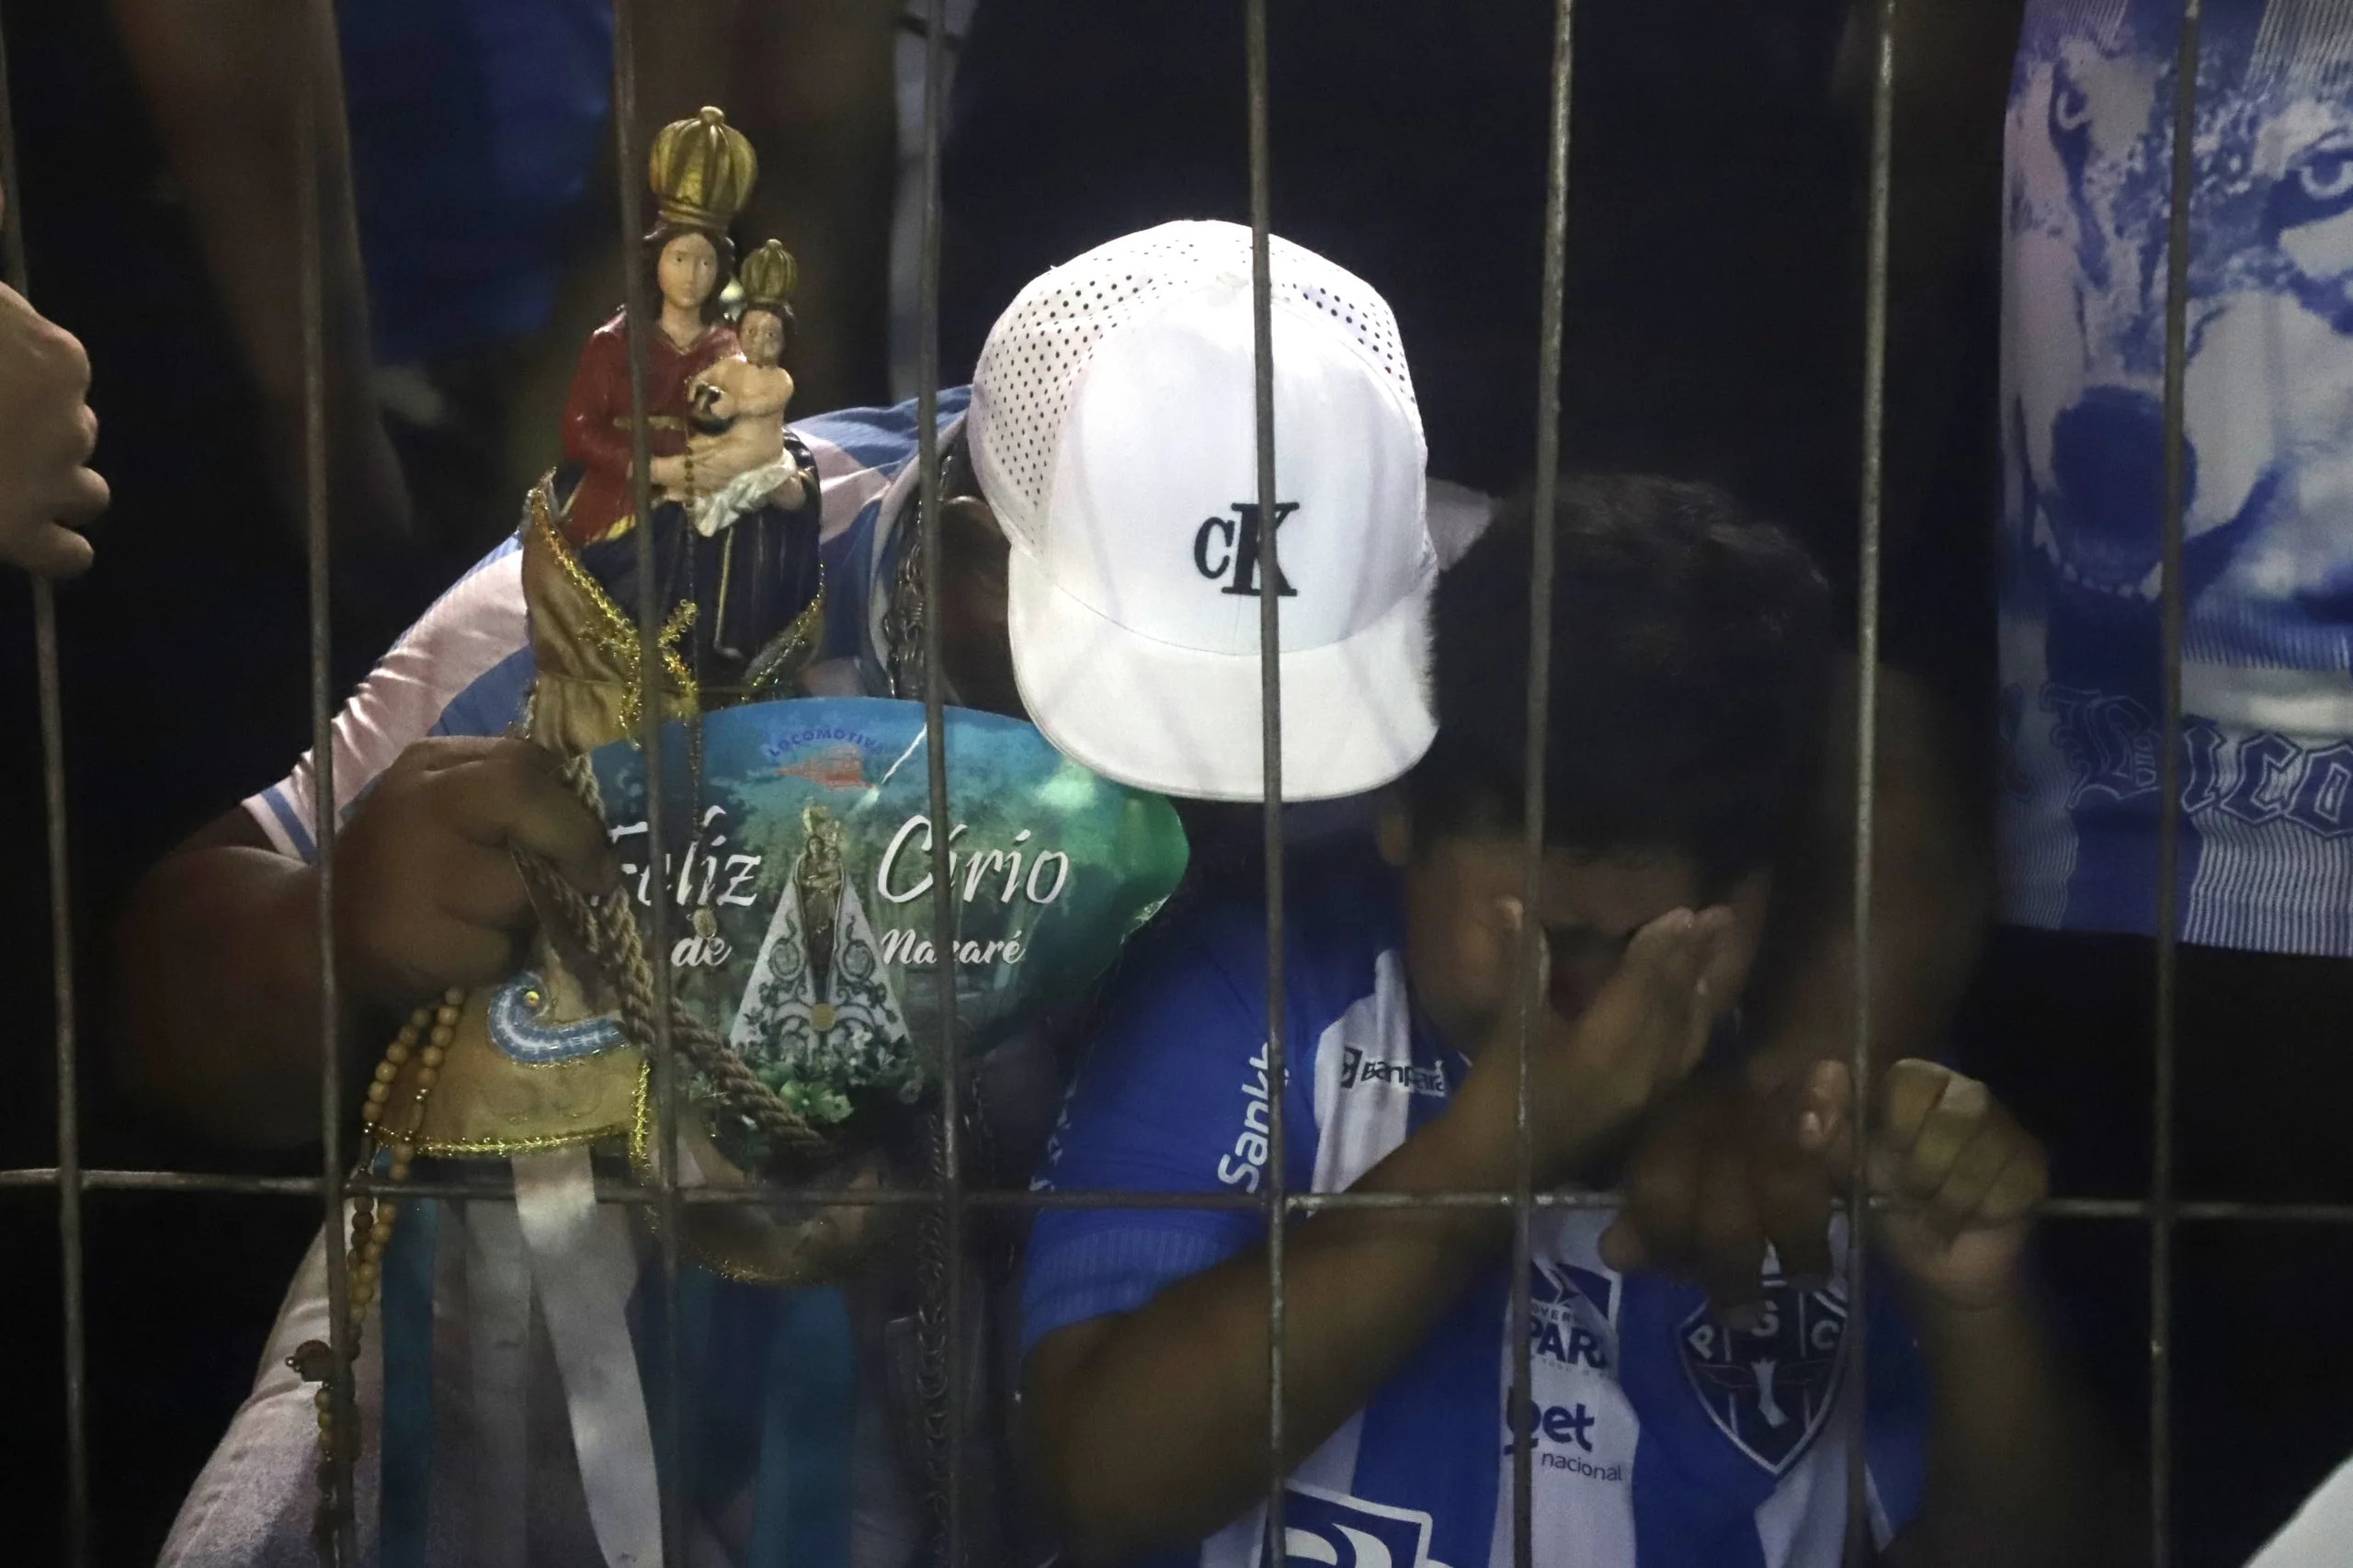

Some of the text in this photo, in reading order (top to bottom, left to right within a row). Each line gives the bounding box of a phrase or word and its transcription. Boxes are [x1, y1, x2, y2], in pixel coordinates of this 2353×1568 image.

[670, 928, 1027, 967] de Naaré
[1541, 1452, 1622, 1482] nacional
